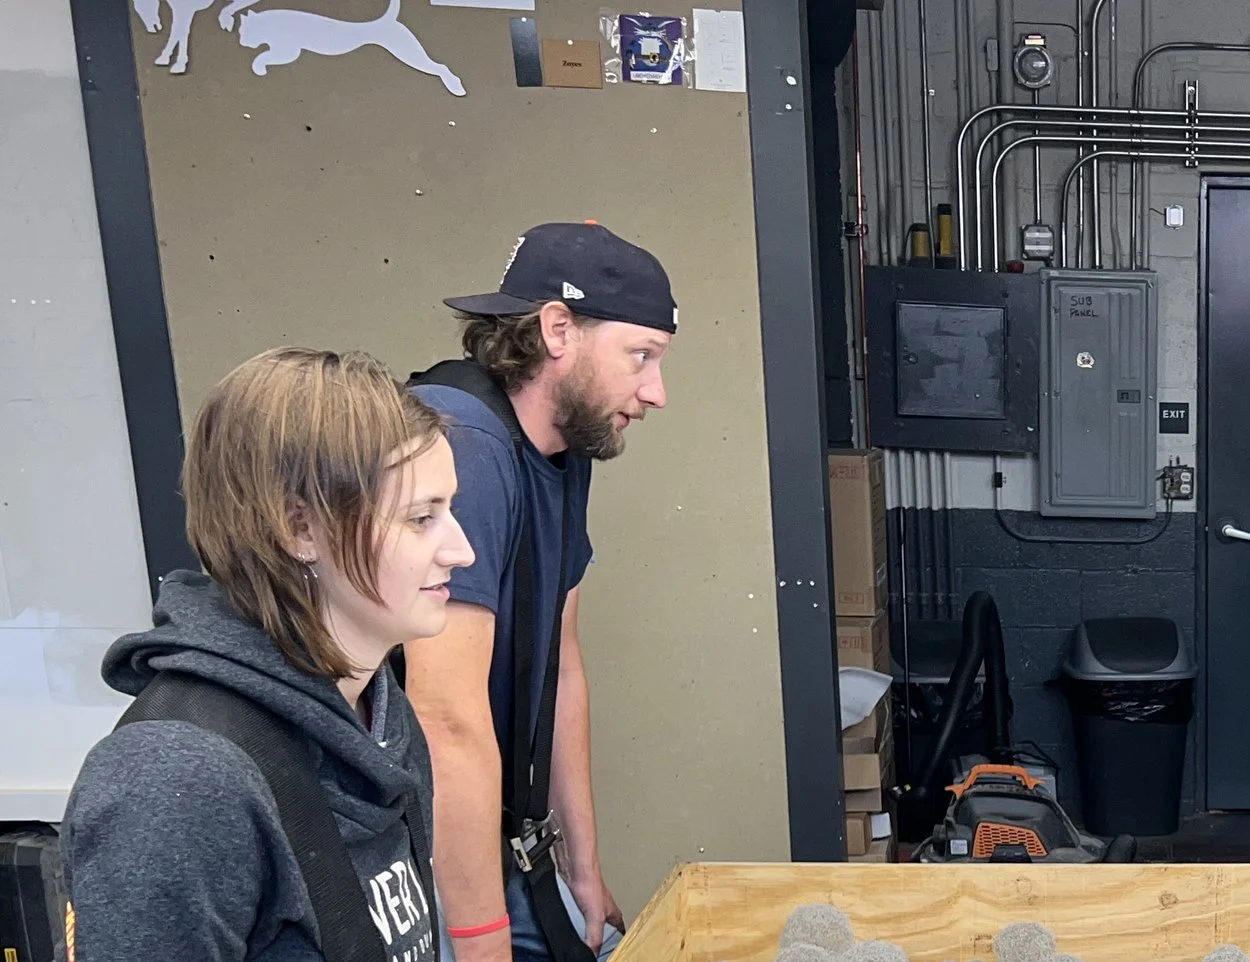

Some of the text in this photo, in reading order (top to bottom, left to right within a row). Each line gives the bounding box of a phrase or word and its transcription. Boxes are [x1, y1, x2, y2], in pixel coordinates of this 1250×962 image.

[1070, 296, 1093, 306] SUB
[1069, 308, 1099, 318] PANEL
[1162, 409, 1186, 419] EXIT
